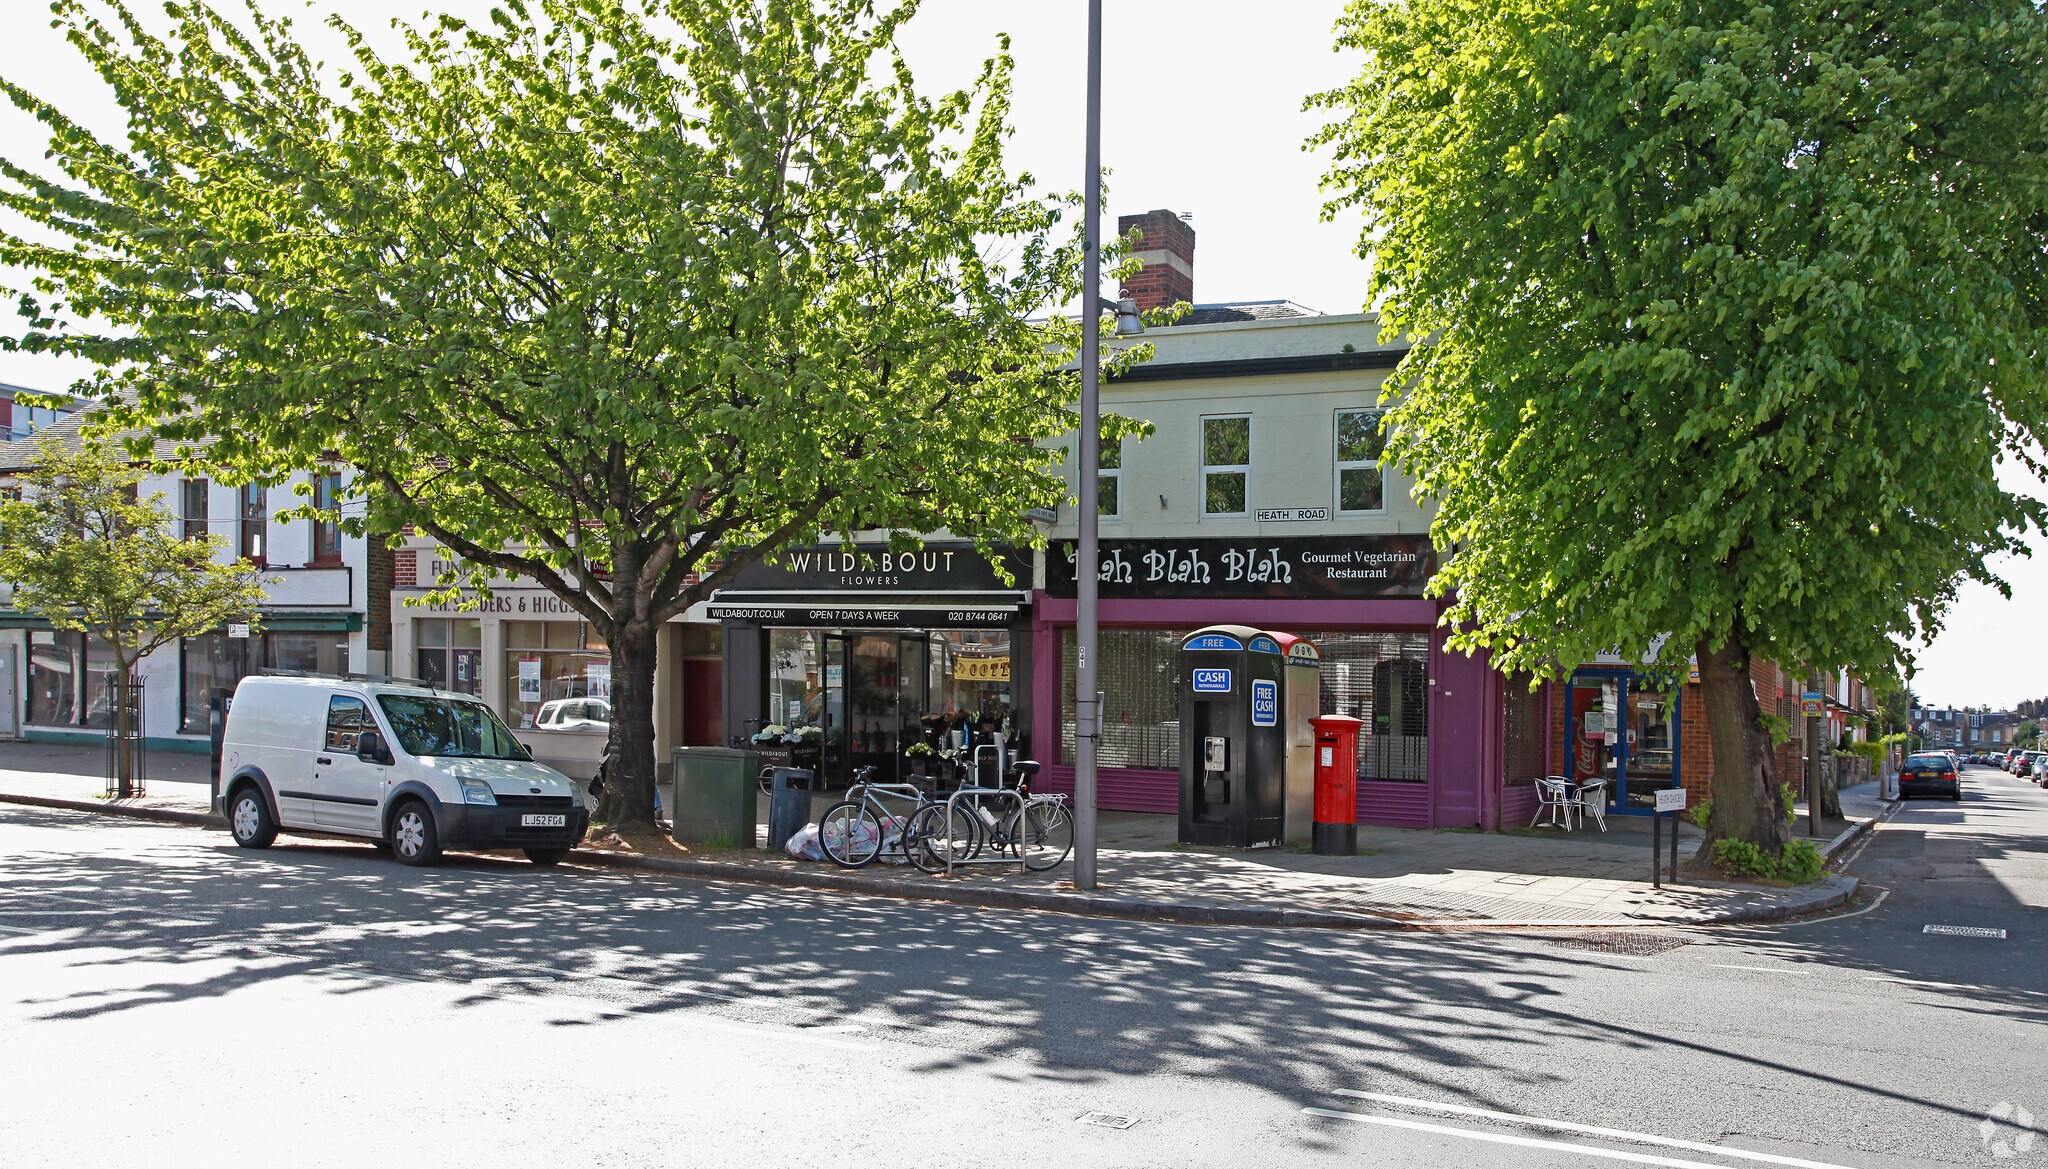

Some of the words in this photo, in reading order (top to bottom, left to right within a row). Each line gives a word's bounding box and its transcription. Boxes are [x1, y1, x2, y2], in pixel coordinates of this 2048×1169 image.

[1257, 510, 1289, 520] HEATH
[1298, 509, 1325, 519] ROAD
[1302, 553, 1352, 564] Gourmet
[1353, 551, 1416, 565] Vegetarian
[1067, 549, 1133, 584] ah
[1142, 548, 1211, 584] Blah
[1220, 547, 1292, 584] Blah
[1326, 567, 1387, 579] Restaurant
[841, 576, 899, 585] FLOWERS
[518, 597, 526, 613] &
[711, 609, 786, 619] WILDABOUT.CO.UK
[809, 610, 833, 620] OPEN
[835, 611, 840, 620] 7
[841, 611, 864, 620] DAYS
[866, 611, 873, 620] A
[875, 611, 899, 620] WEEK
[948, 612, 963, 621] 020
[965, 612, 984, 621] 8744
[986, 612, 1008, 621] 0641
[1202, 639, 1224, 647] FREE
[1258, 641, 1271, 650] FREE
[1198, 672, 1225, 683] CASH
[1257, 687, 1272, 700] FREE
[1255, 700, 1273, 712] CASH
[1659, 794, 1669, 804] HEATH
[524, 816, 546, 825] LJ52
[547, 816, 563, 825] FGA
